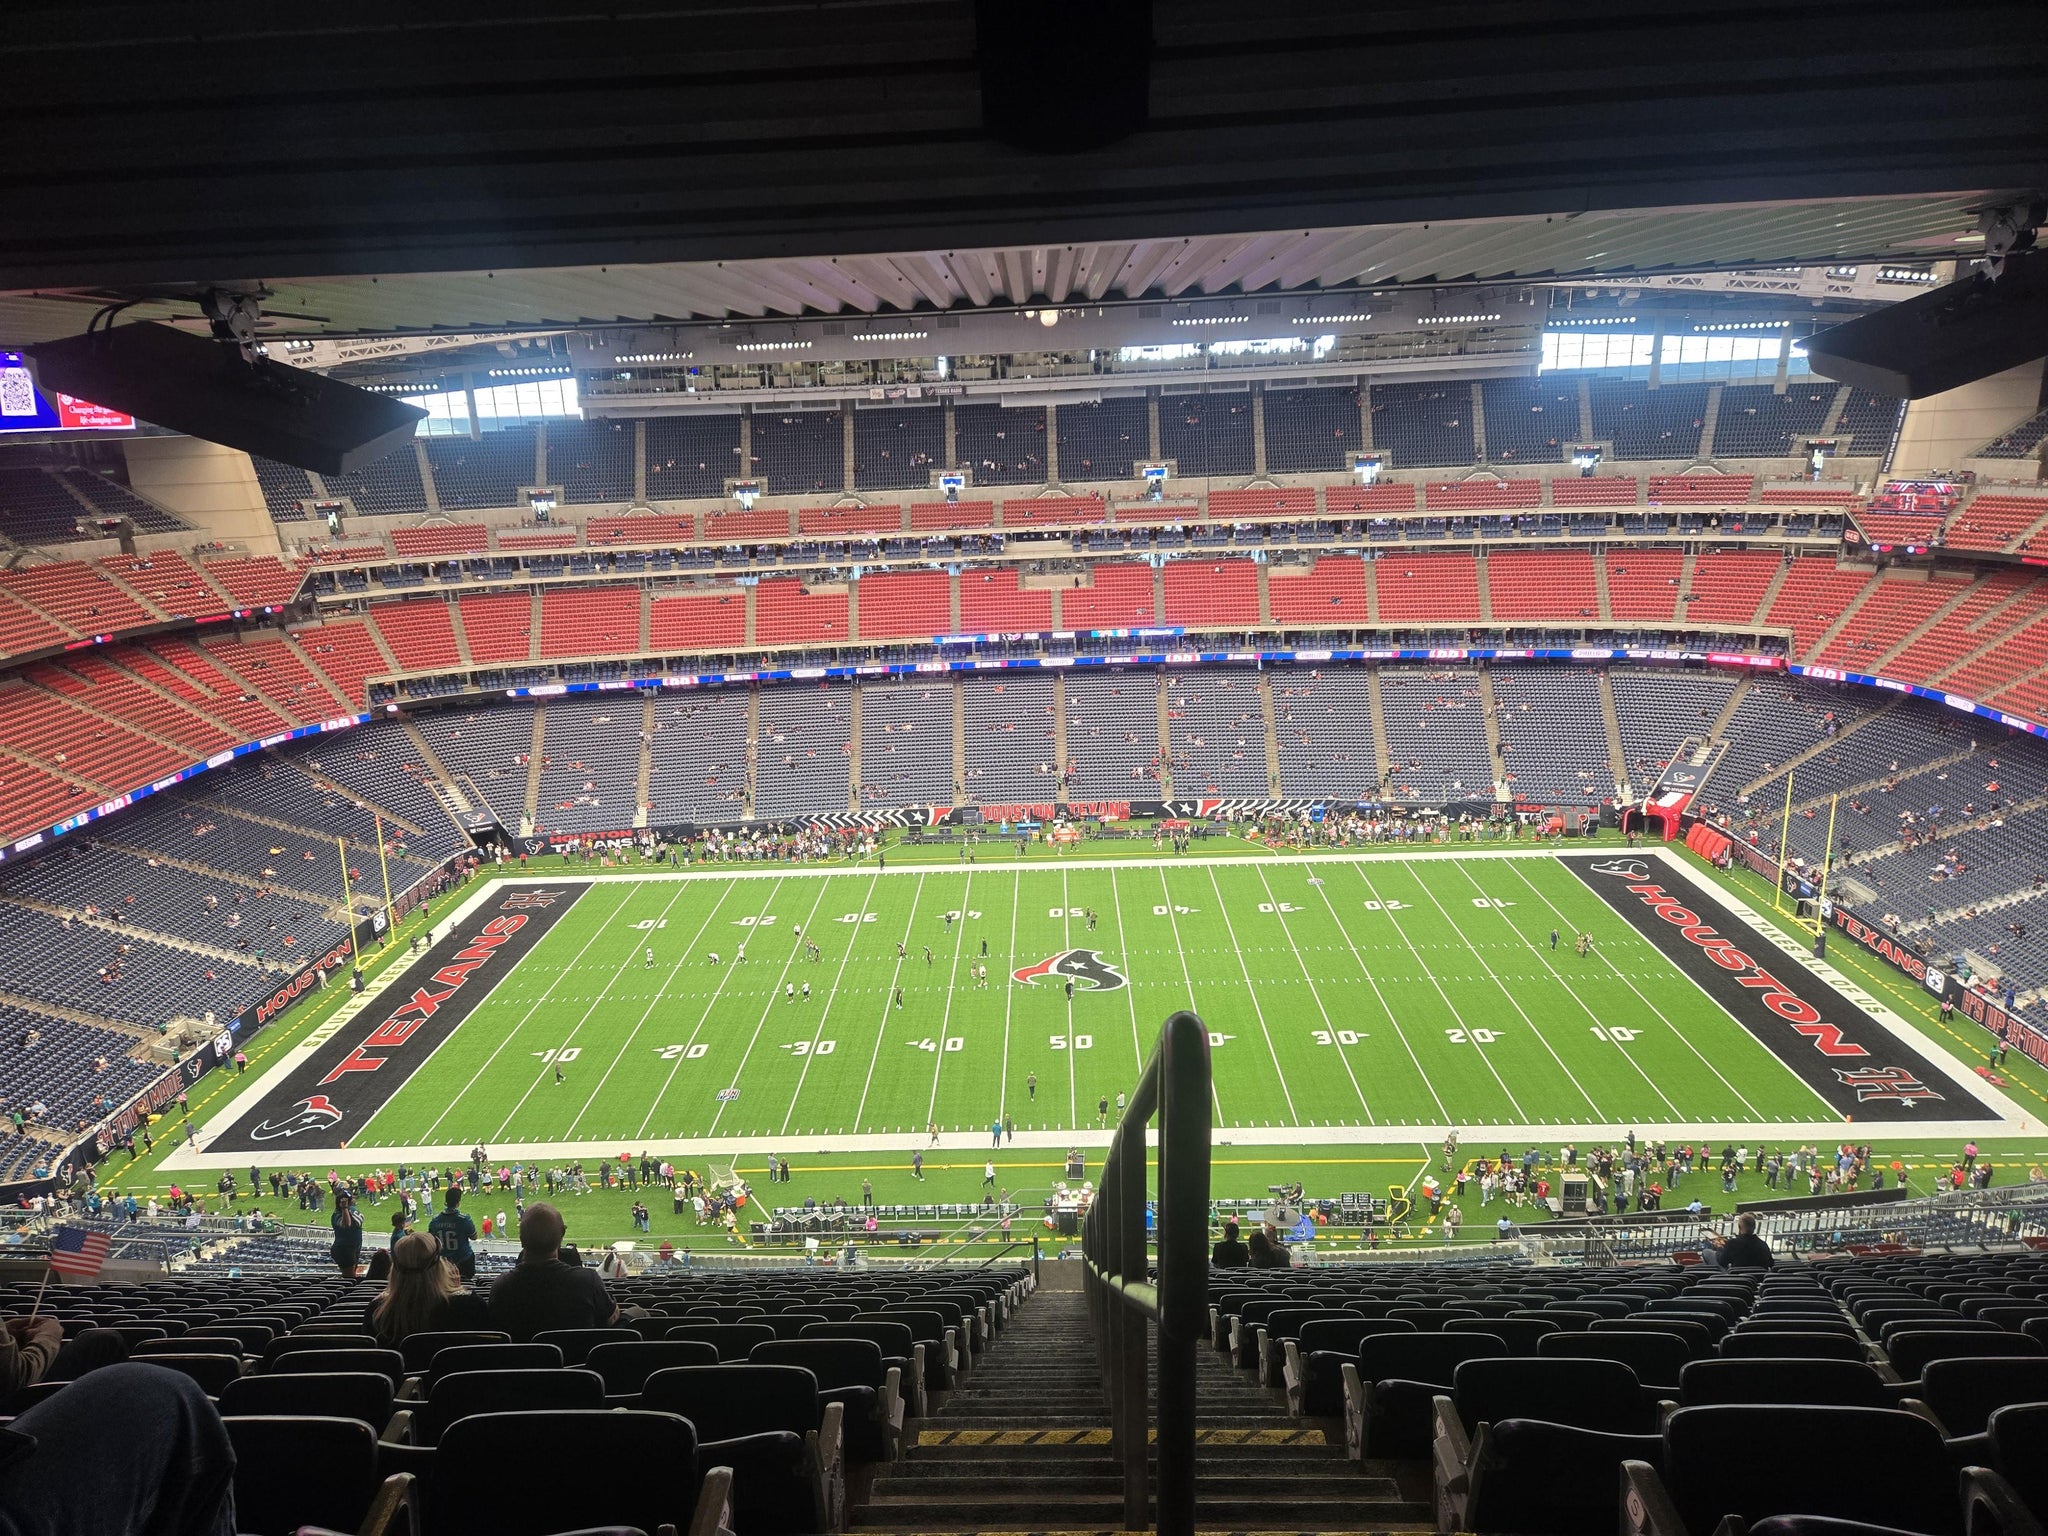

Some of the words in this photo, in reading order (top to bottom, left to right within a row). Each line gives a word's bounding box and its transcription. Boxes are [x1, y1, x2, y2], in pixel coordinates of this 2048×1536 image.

[979, 803, 1056, 823] HOUSTON
[1067, 801, 1131, 822] TEXANS
[549, 829, 633, 845] HOUSTON
[1833, 907, 1926, 980] TEXANS
[1626, 884, 1871, 1057] HOUSTON
[1734, 909, 1758, 918] IT
[1751, 921, 1804, 952] TAKES
[1797, 956, 1830, 975] ALL
[1830, 980, 1859, 993] OF
[1855, 1000, 1887, 1014] US
[256, 938, 351, 1023] HOUSTON
[317, 913, 529, 1087] TEXANS
[302, 1003, 364, 1048] SALUTE
[357, 986, 383, 998] TO
[1985, 1005, 2006, 1034] UP
[918, 1037, 964, 1053] 40
[1049, 1034, 1093, 1050] 50
[1311, 1030, 1360, 1046] 30
[1445, 1029, 1495, 1044] 20
[1590, 1027, 1632, 1042] 10
[541, 1047, 582, 1062] 10
[660, 1043, 709, 1059] 20
[791, 1040, 837, 1055] 30
[148, 1069, 185, 1112] MADE
[437, 1230, 459, 1251] 16
